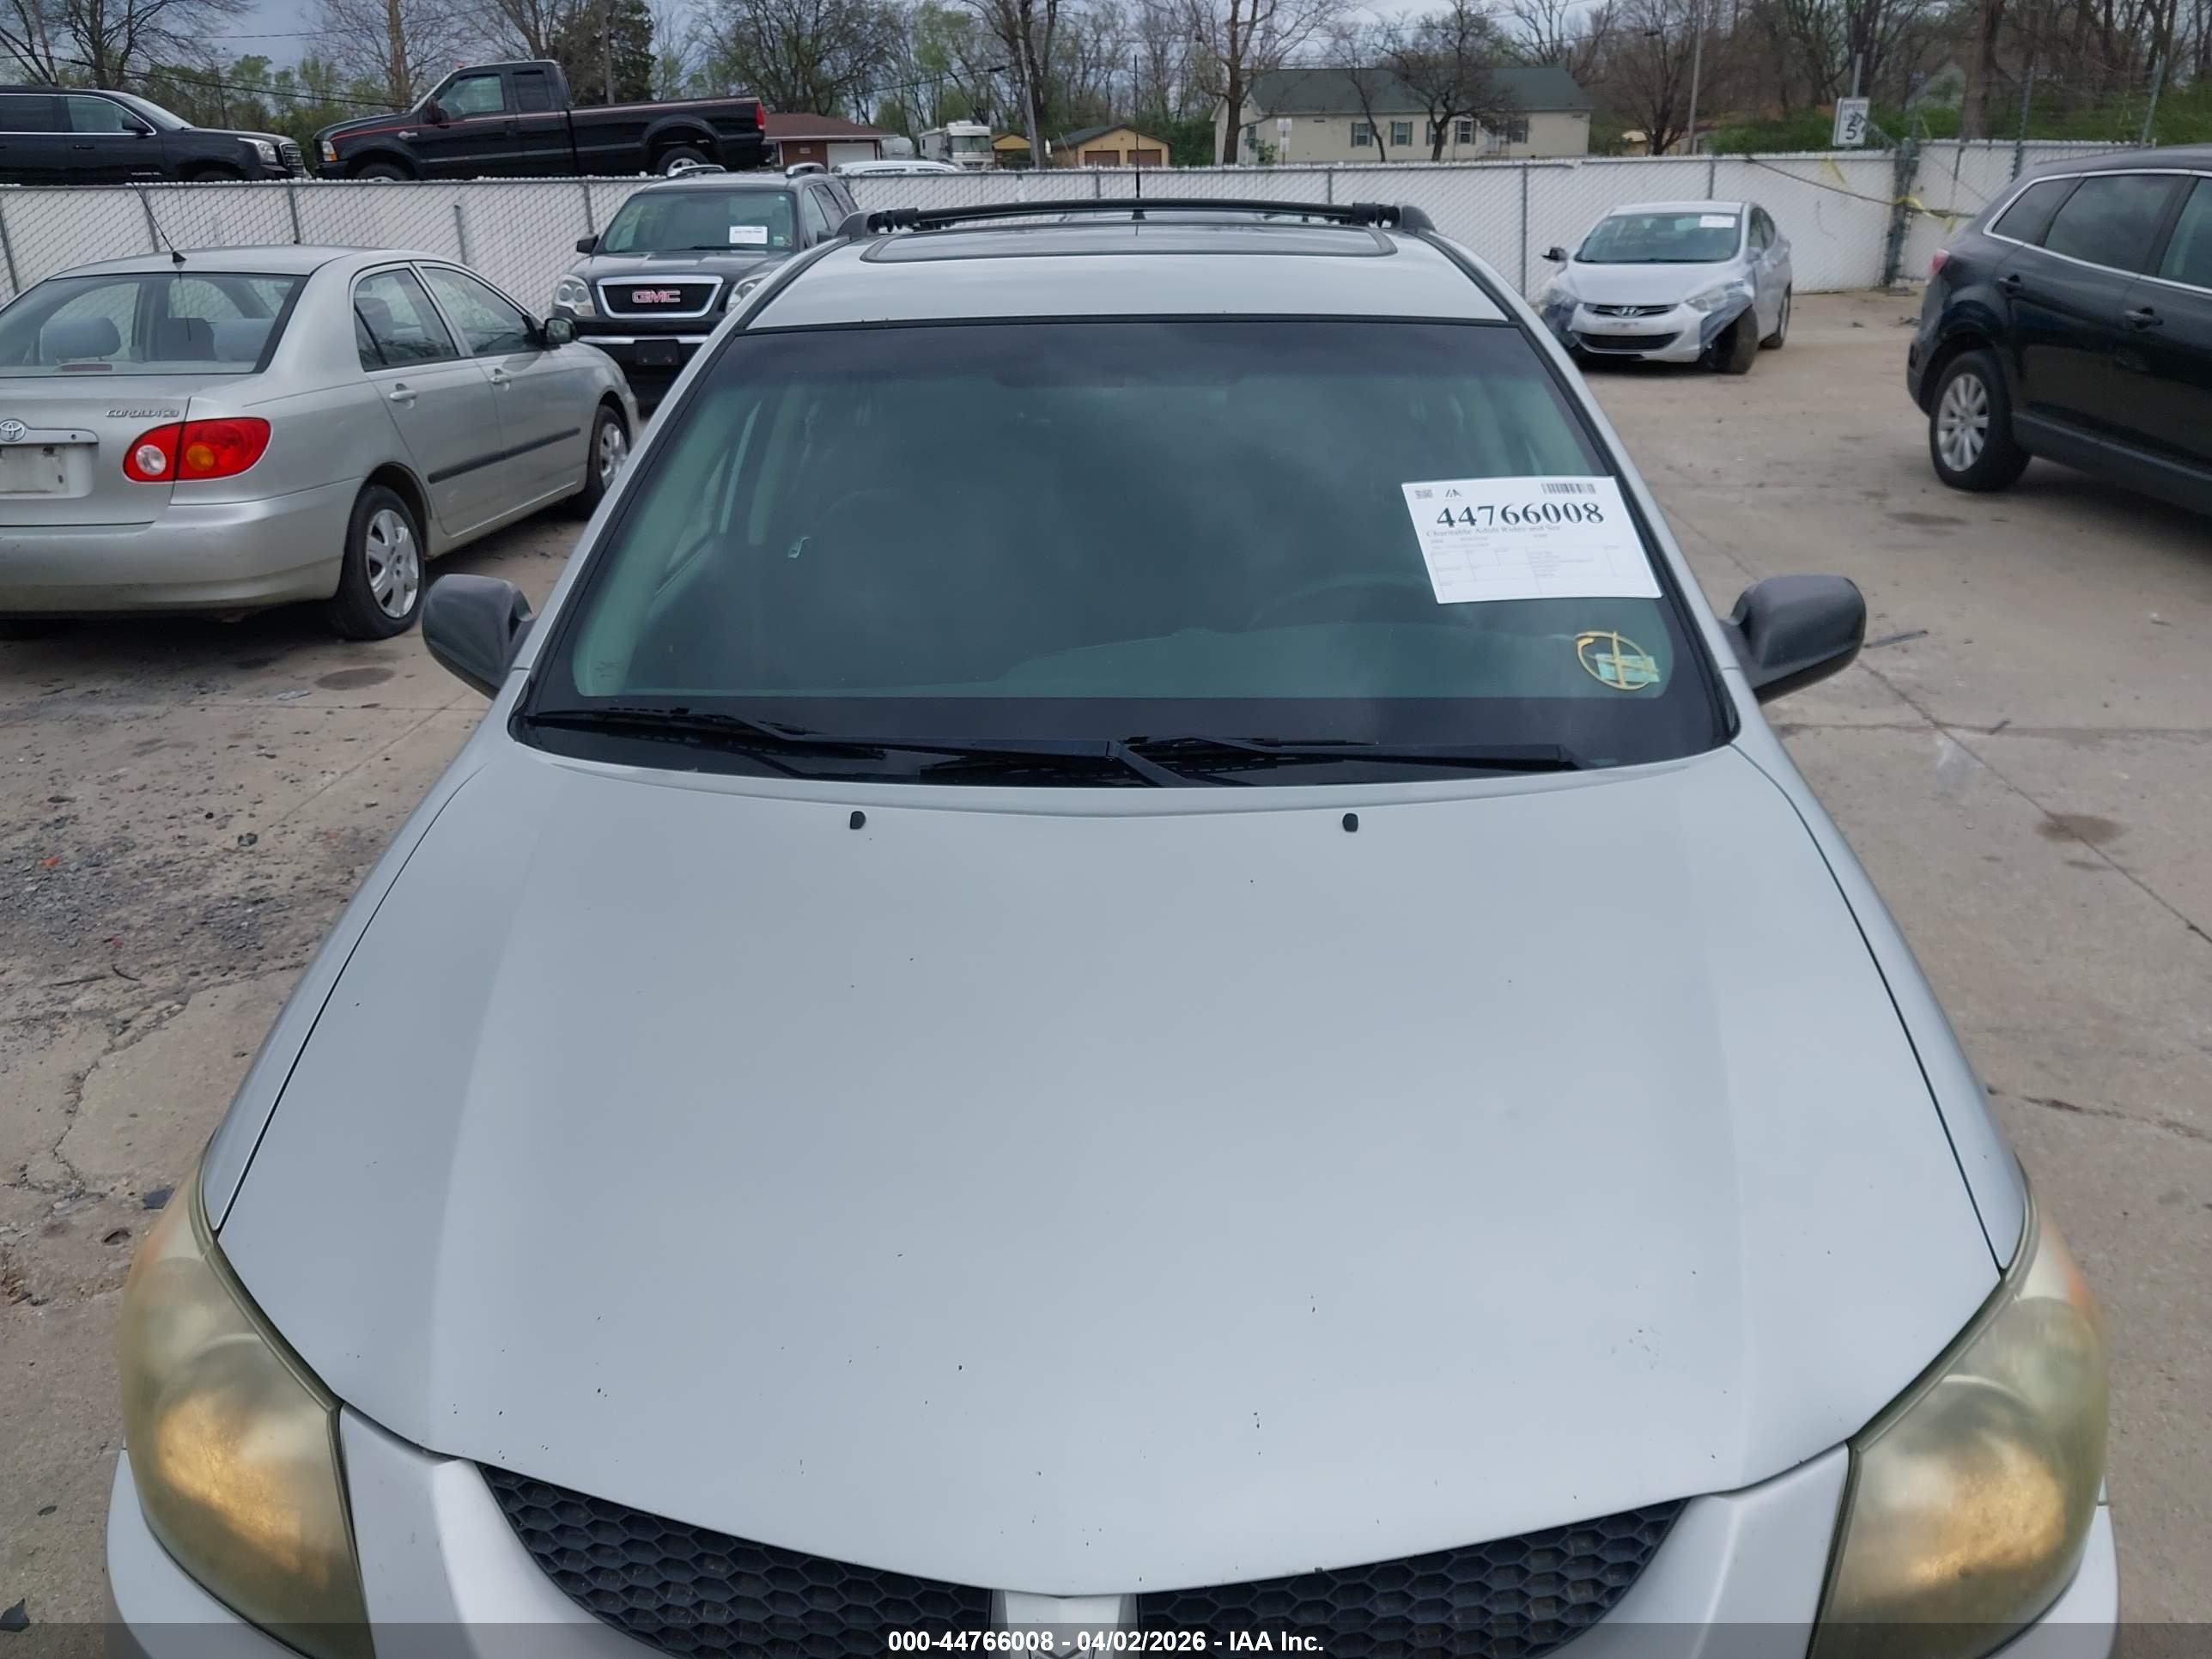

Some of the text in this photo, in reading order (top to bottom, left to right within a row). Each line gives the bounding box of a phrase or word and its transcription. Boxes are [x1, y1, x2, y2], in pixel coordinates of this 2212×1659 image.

[632, 289, 681, 304] GMC
[105, 409, 161, 418] COROLLA
[1436, 501, 1605, 528] 44766008
[1425, 529, 1472, 538] Charitable
